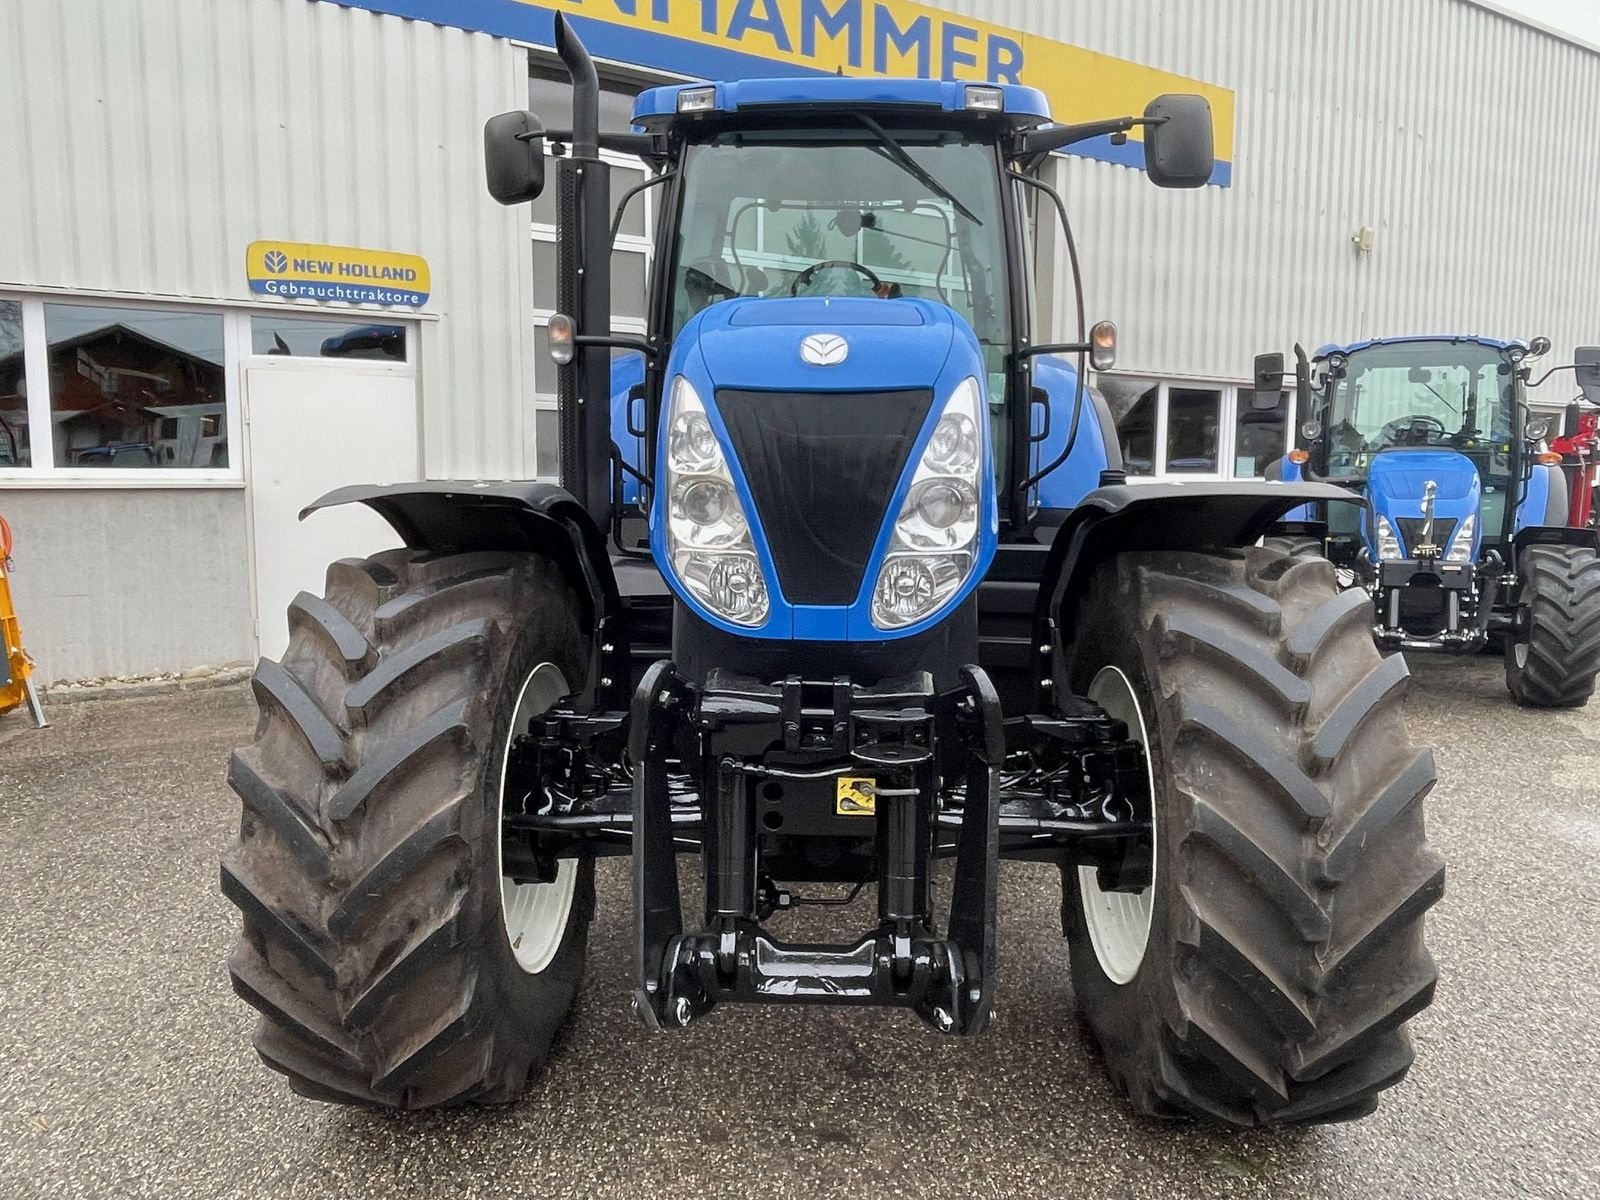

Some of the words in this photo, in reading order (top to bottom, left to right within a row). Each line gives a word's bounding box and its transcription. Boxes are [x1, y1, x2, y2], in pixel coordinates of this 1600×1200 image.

[567, 0, 1024, 85] AMMER
[293, 258, 333, 275] NEW
[338, 262, 416, 281] HOLLAND
[265, 280, 419, 304] Gebrauchttraktore
